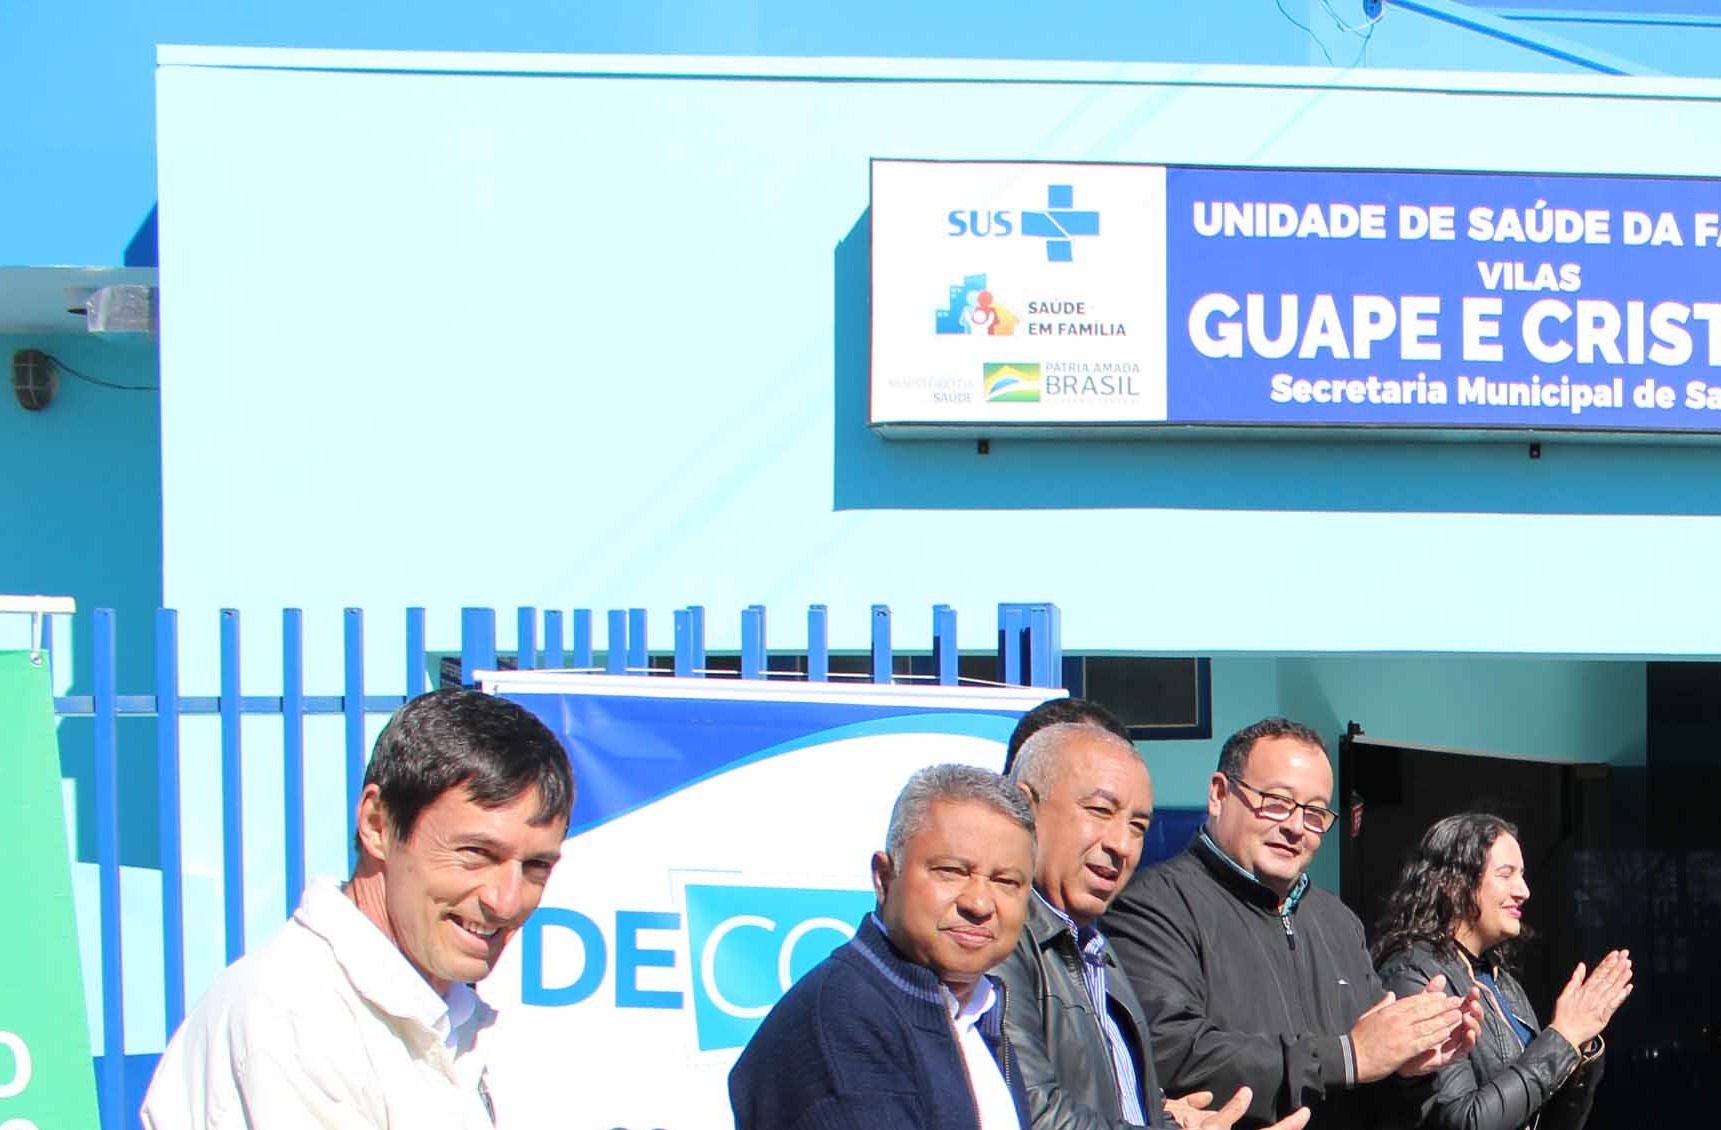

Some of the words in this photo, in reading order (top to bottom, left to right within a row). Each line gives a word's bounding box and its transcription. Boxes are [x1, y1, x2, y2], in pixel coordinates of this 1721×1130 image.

[948, 210, 1013, 237] SUS
[1193, 202, 1386, 239] UNIDADE
[1399, 205, 1455, 240] DE
[1467, 199, 1611, 244] SAÚDE
[1623, 211, 1683, 246] DA
[1477, 261, 1581, 292] VILAS
[1027, 297, 1087, 316] SAÚDE
[1027, 321, 1054, 337] EM
[1057, 319, 1128, 337] FAMÍLIA
[1188, 293, 1441, 360] GUAPE
[1462, 297, 1503, 362] E
[1093, 362, 1141, 374] AMADA
[1045, 375, 1141, 396] BRASIL
[1270, 373, 1447, 405] Secretaria
[1457, 375, 1623, 414] Municipal
[1633, 378, 1676, 409] de
